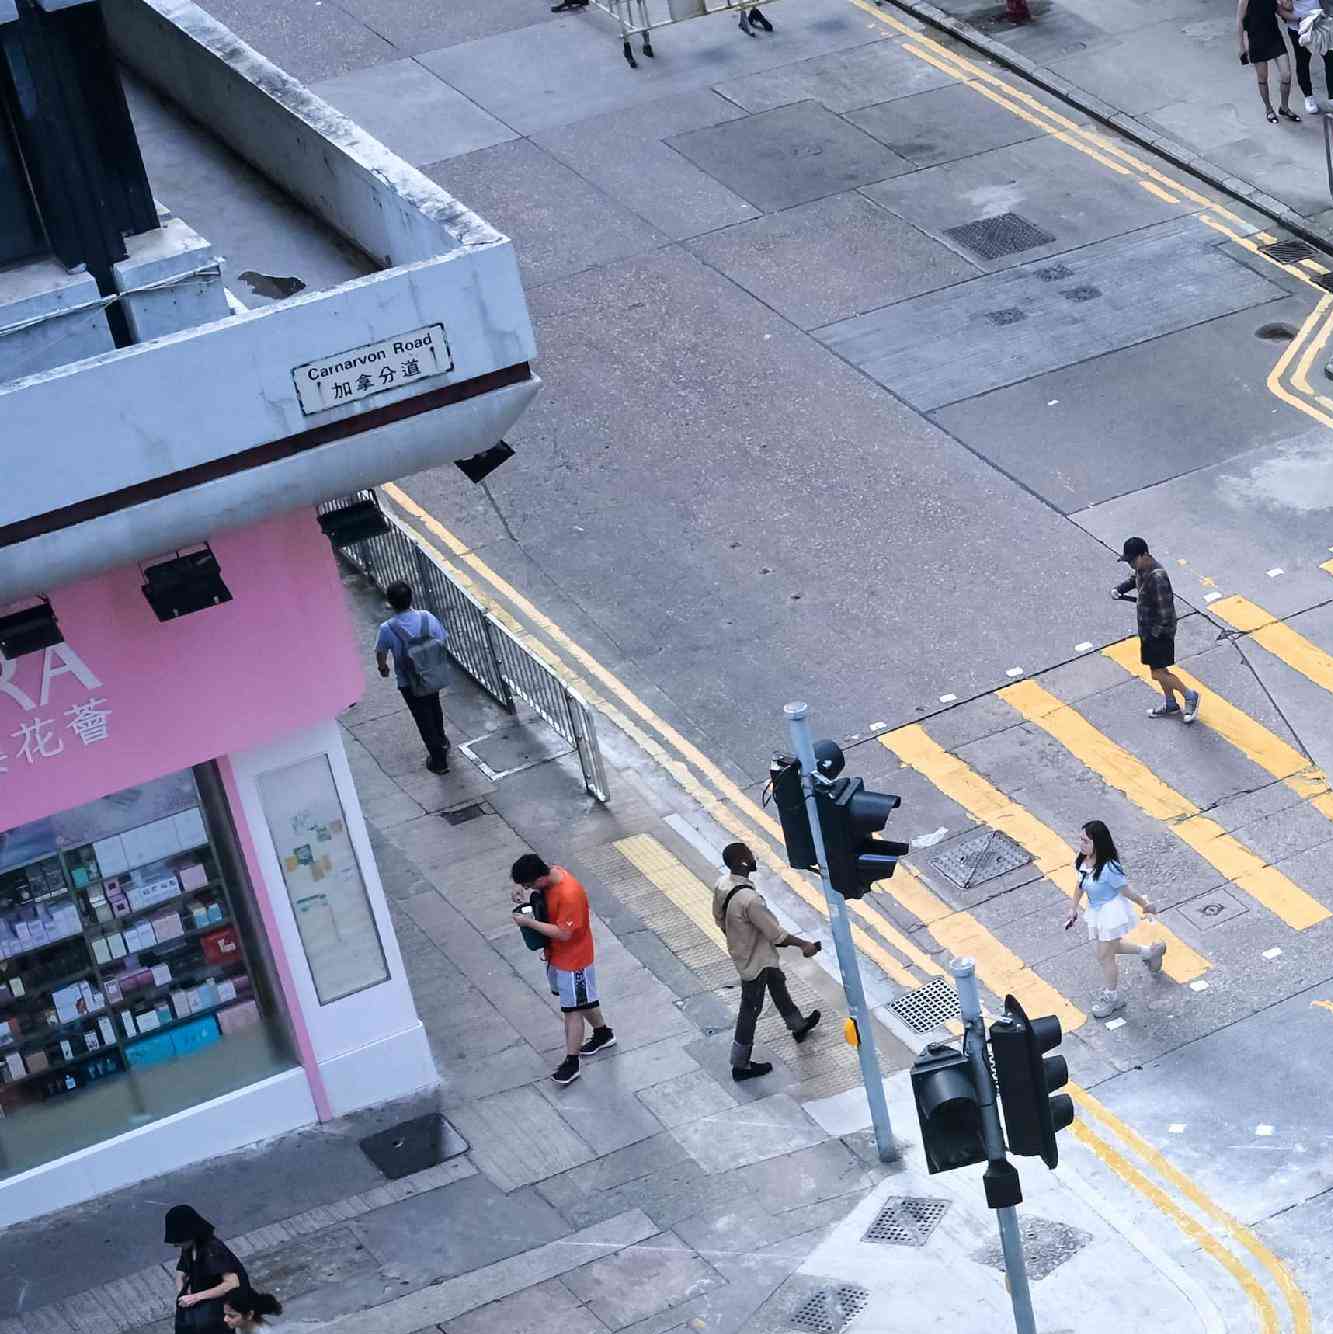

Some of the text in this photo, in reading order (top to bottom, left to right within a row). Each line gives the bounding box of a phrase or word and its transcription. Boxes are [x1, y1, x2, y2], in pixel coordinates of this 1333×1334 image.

[307, 332, 432, 381] Carnarvon Road
[331, 357, 422, 400] 加拿分道
[0, 698, 113, 773] 花薈
